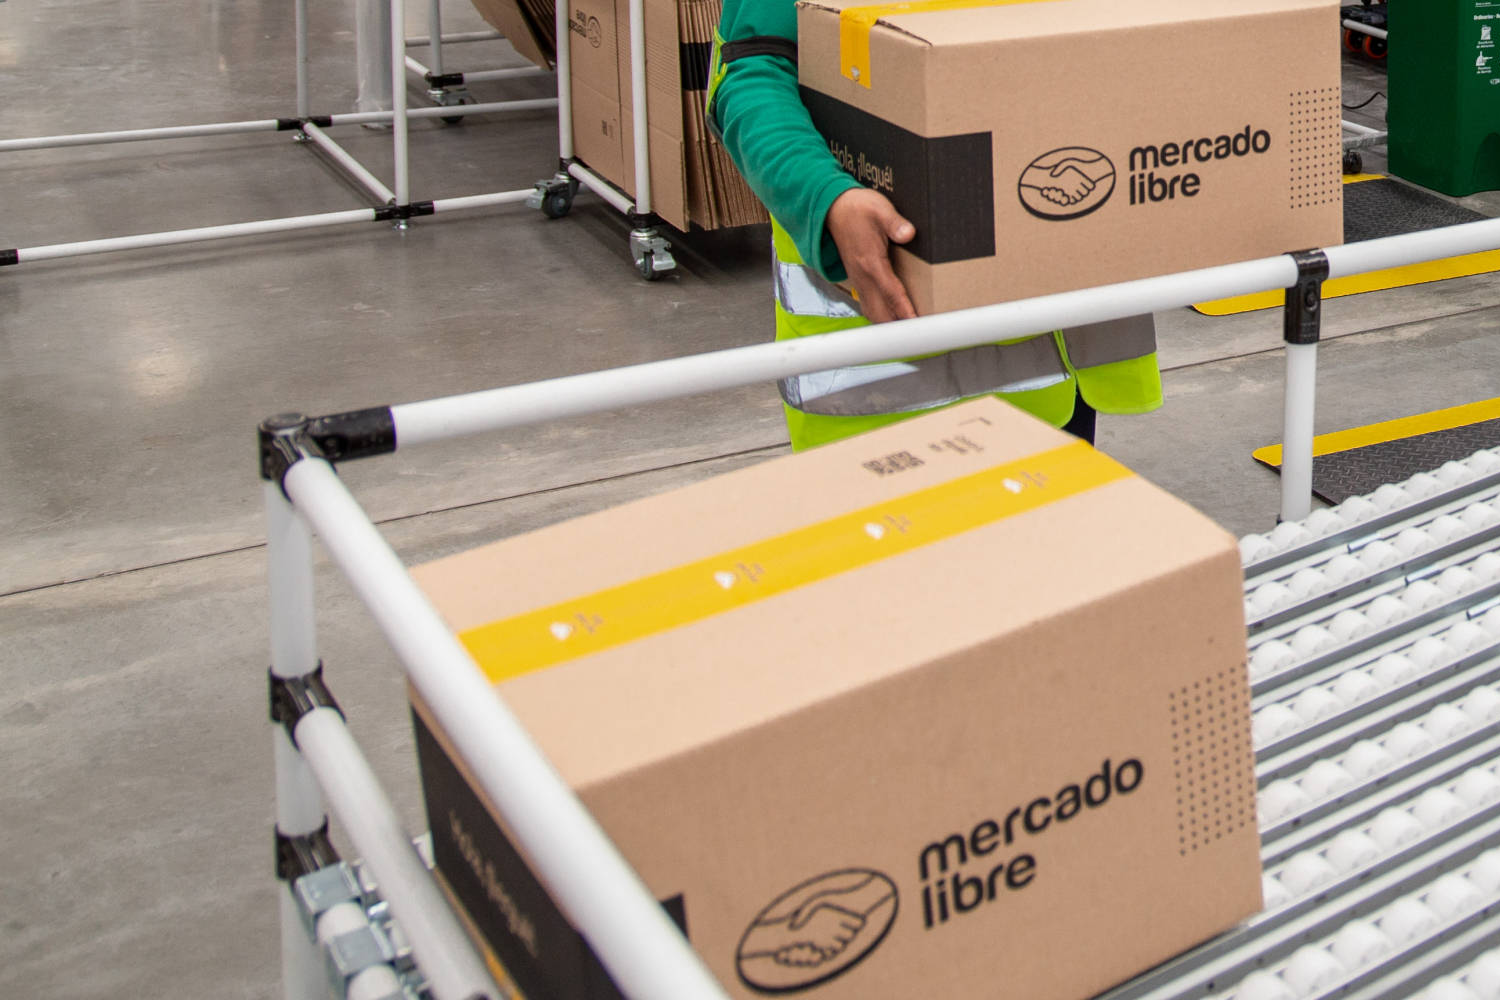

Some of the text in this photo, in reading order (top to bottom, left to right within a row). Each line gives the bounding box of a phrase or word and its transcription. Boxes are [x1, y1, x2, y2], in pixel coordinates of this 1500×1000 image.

[830, 139, 857, 178] Hola,
[1128, 125, 1272, 172] mercado
[1128, 170, 1202, 207] libre
[917, 756, 1146, 881] mercado
[921, 852, 1038, 930] libre
